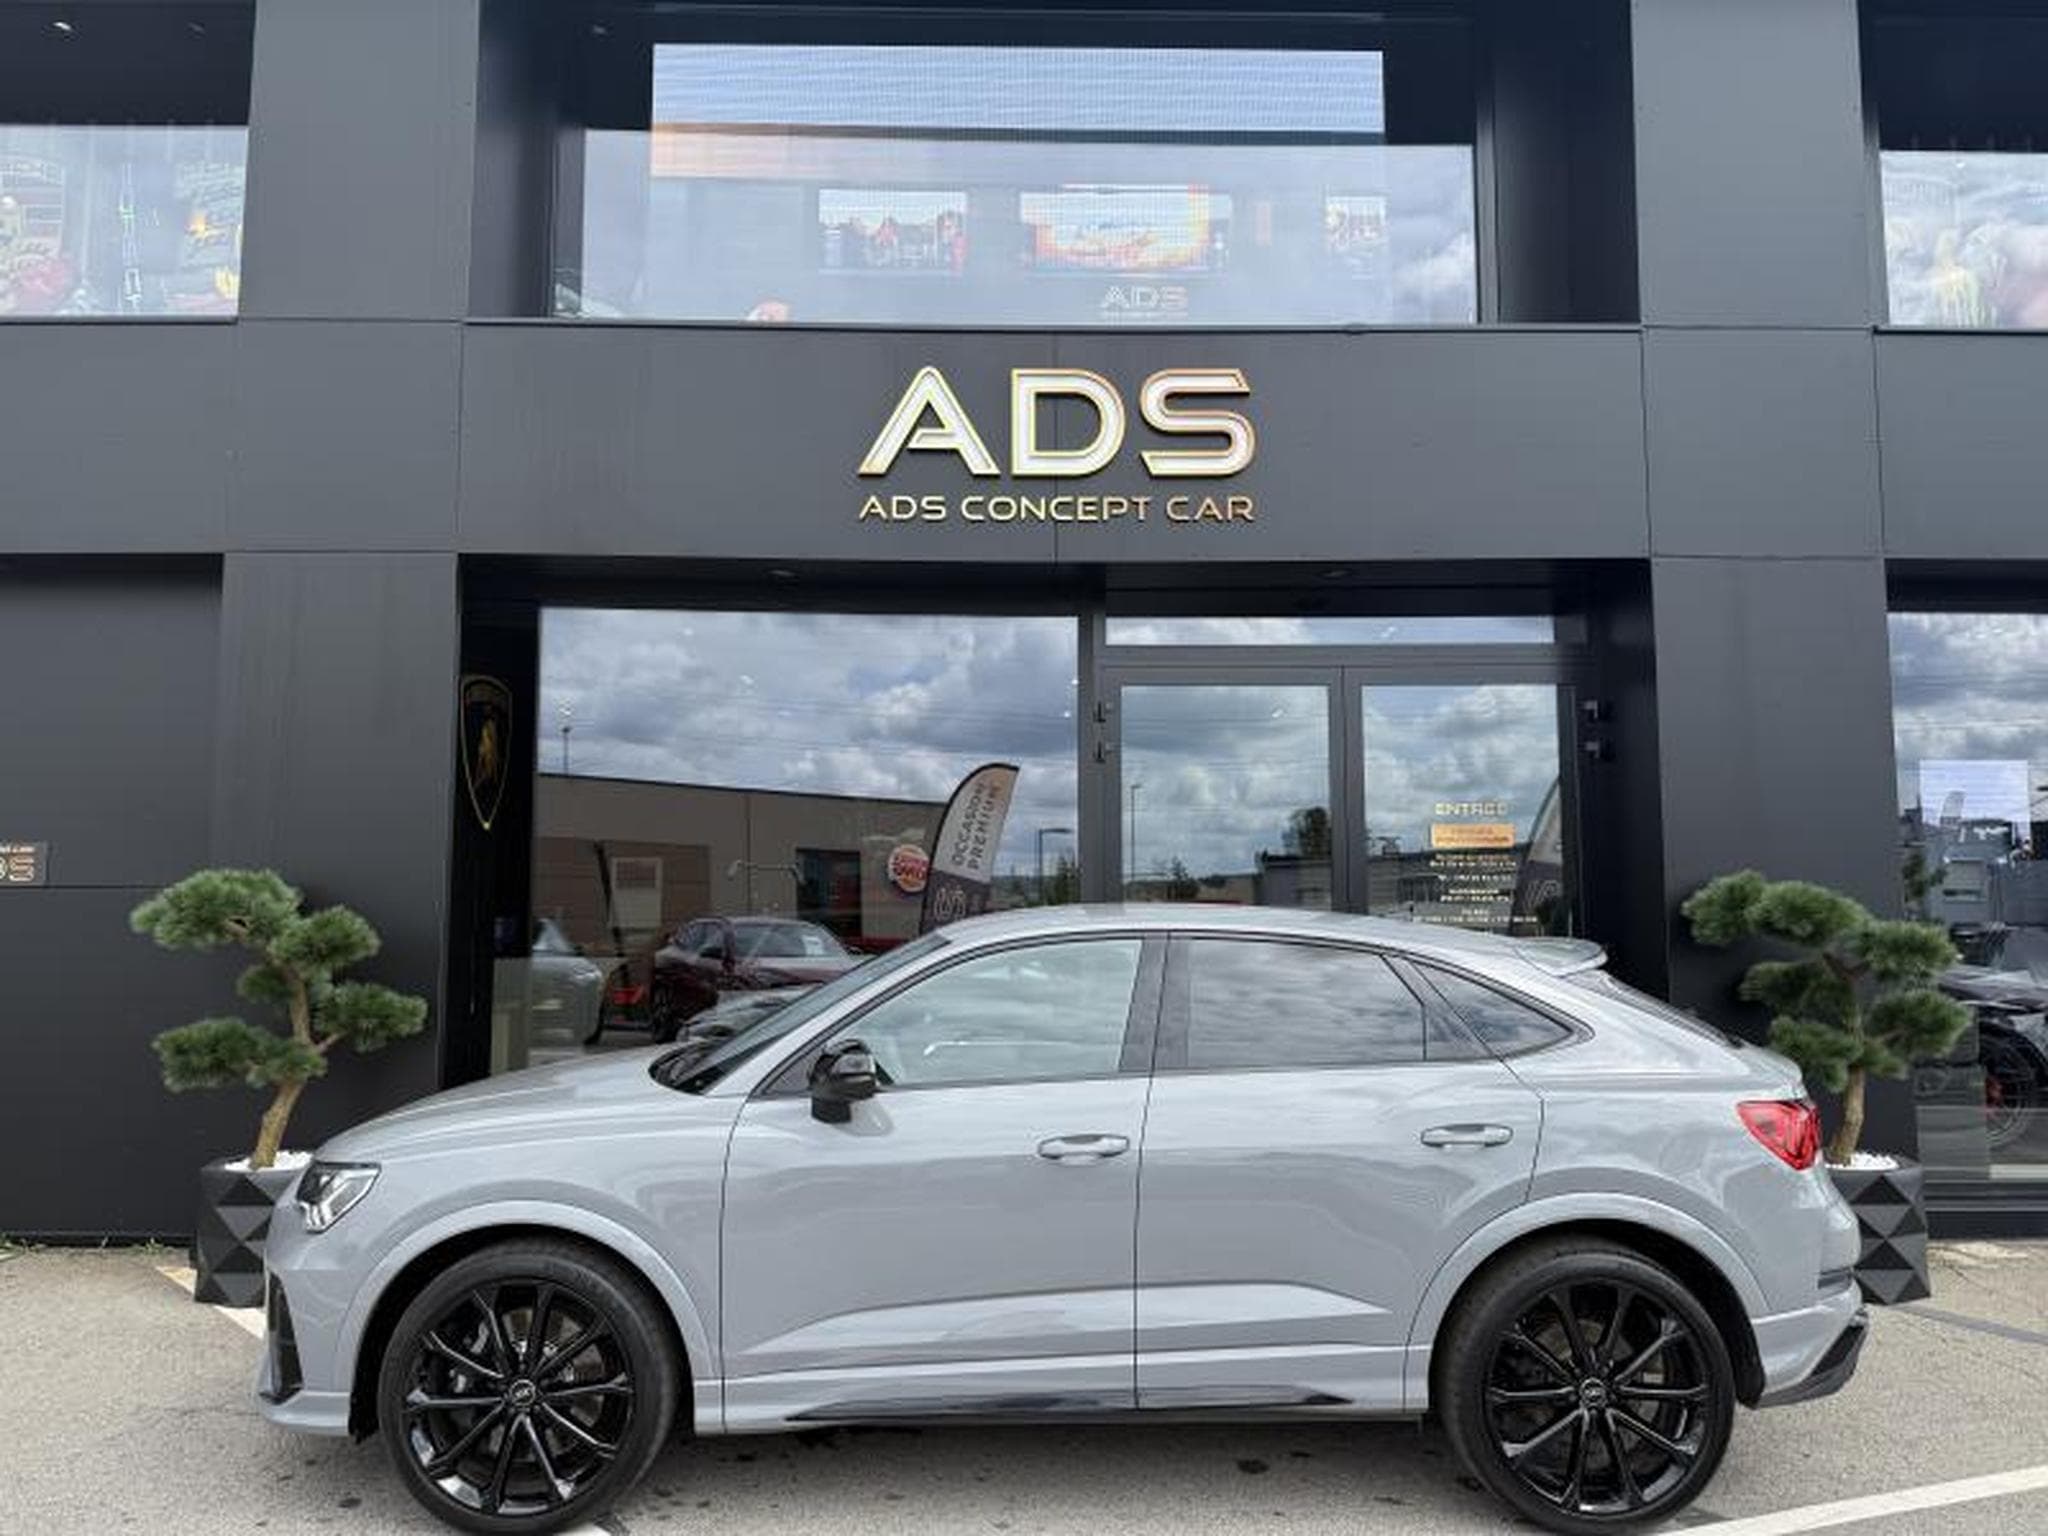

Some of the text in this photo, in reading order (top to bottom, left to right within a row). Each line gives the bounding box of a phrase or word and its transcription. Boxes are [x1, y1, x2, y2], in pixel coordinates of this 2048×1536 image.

[1100, 286, 1189, 308] ADS
[858, 365, 1256, 477] ADS
[858, 496, 1255, 523] ADS CONCEPT CAR
